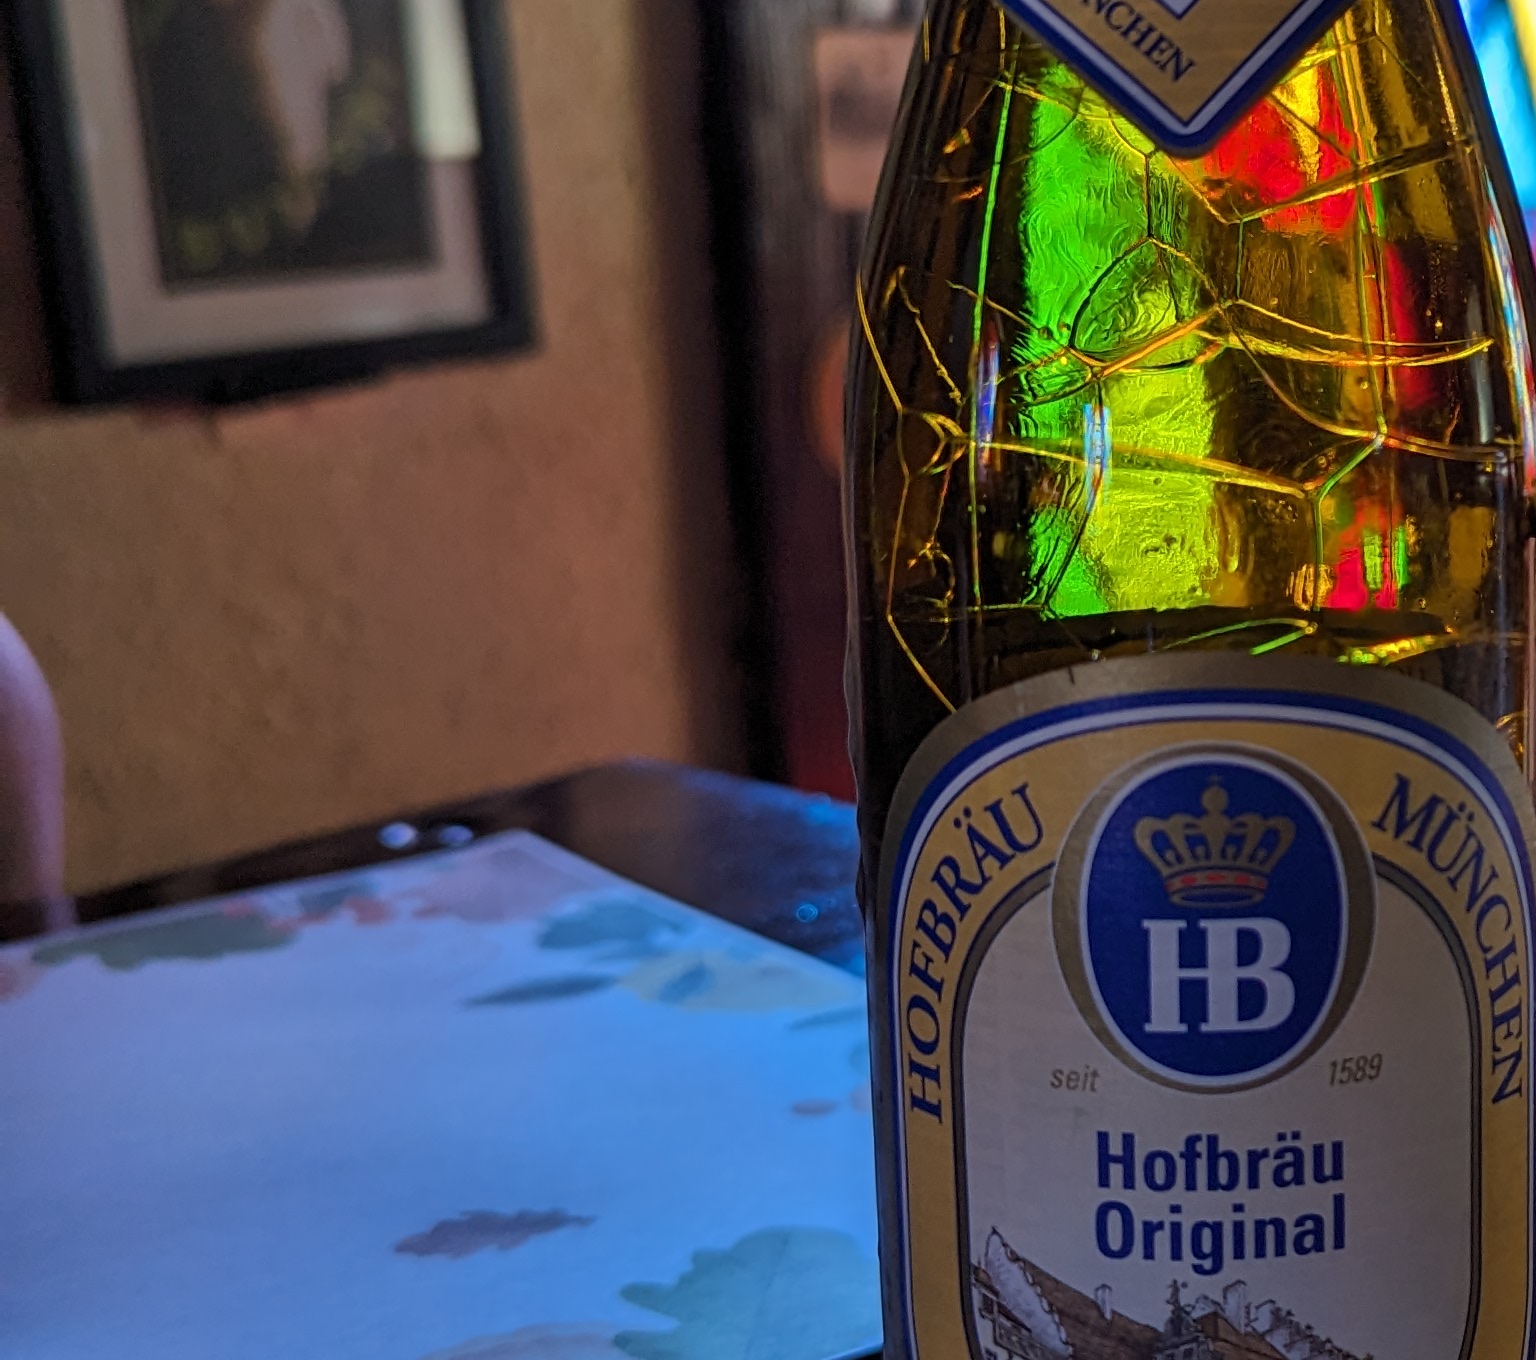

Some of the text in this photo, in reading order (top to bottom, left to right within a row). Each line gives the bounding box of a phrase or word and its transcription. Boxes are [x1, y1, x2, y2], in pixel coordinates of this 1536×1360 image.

[907, 772, 1523, 1125] HOFBRÄU MÜNCHEN
[1141, 916, 1296, 1034] HB
[1049, 1053, 1383, 1092] seit 1589
[1096, 1130, 1344, 1192] Hofbräu
[1095, 1193, 1346, 1276] Original
